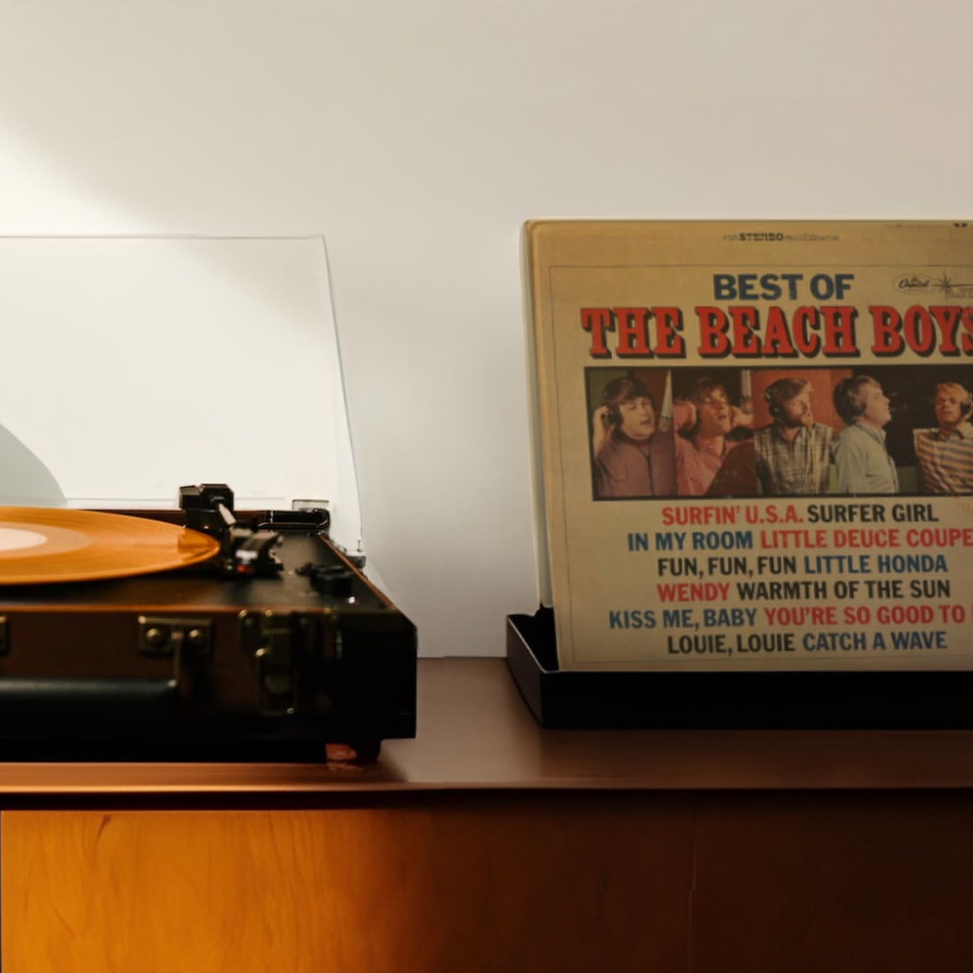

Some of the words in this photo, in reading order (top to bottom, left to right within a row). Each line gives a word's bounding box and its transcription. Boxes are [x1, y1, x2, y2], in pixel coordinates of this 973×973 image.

[739, 232, 784, 241] STEREO
[713, 273, 803, 301] BEST
[809, 273, 855, 300] OF
[580, 306, 686, 359] THE
[694, 305, 861, 359] BEACH
[661, 505, 740, 525] SURFIN'
[745, 505, 803, 525] U.S.A.
[807, 504, 885, 523] SURFER
[891, 503, 939, 523] GIRL
[627, 533, 648, 551] IN
[655, 532, 687, 551] MY
[692, 531, 753, 550] ROOM
[760, 530, 827, 549] LITTLE
[833, 529, 901, 548] DEUCE
[905, 528, 973, 547] COUPE
[657, 557, 703, 579] FUN,
[707, 557, 753, 578] FUN,
[757, 556, 797, 575] FUN
[804, 555, 871, 574] LITTLE
[877, 554, 948, 573] HONDA
[657, 582, 730, 602] WENDY
[736, 581, 827, 601] WARMTH
[833, 580, 859, 599] OF
[864, 580, 904, 599] THE
[909, 579, 951, 598] SUN
[609, 610, 656, 629] KISS
[663, 609, 700, 631] ME,
[703, 608, 757, 627] BABY
[763, 606, 837, 626] YOU'RE
[843, 605, 871, 625] SO
[877, 605, 934, 624] GOOD
[937, 605, 965, 623] TO
[667, 635, 733, 656] LOUIE,
[737, 633, 795, 653] LOUIE
[803, 631, 867, 651] CATCH
[872, 631, 886, 650] A
[891, 631, 948, 650] WAVE
